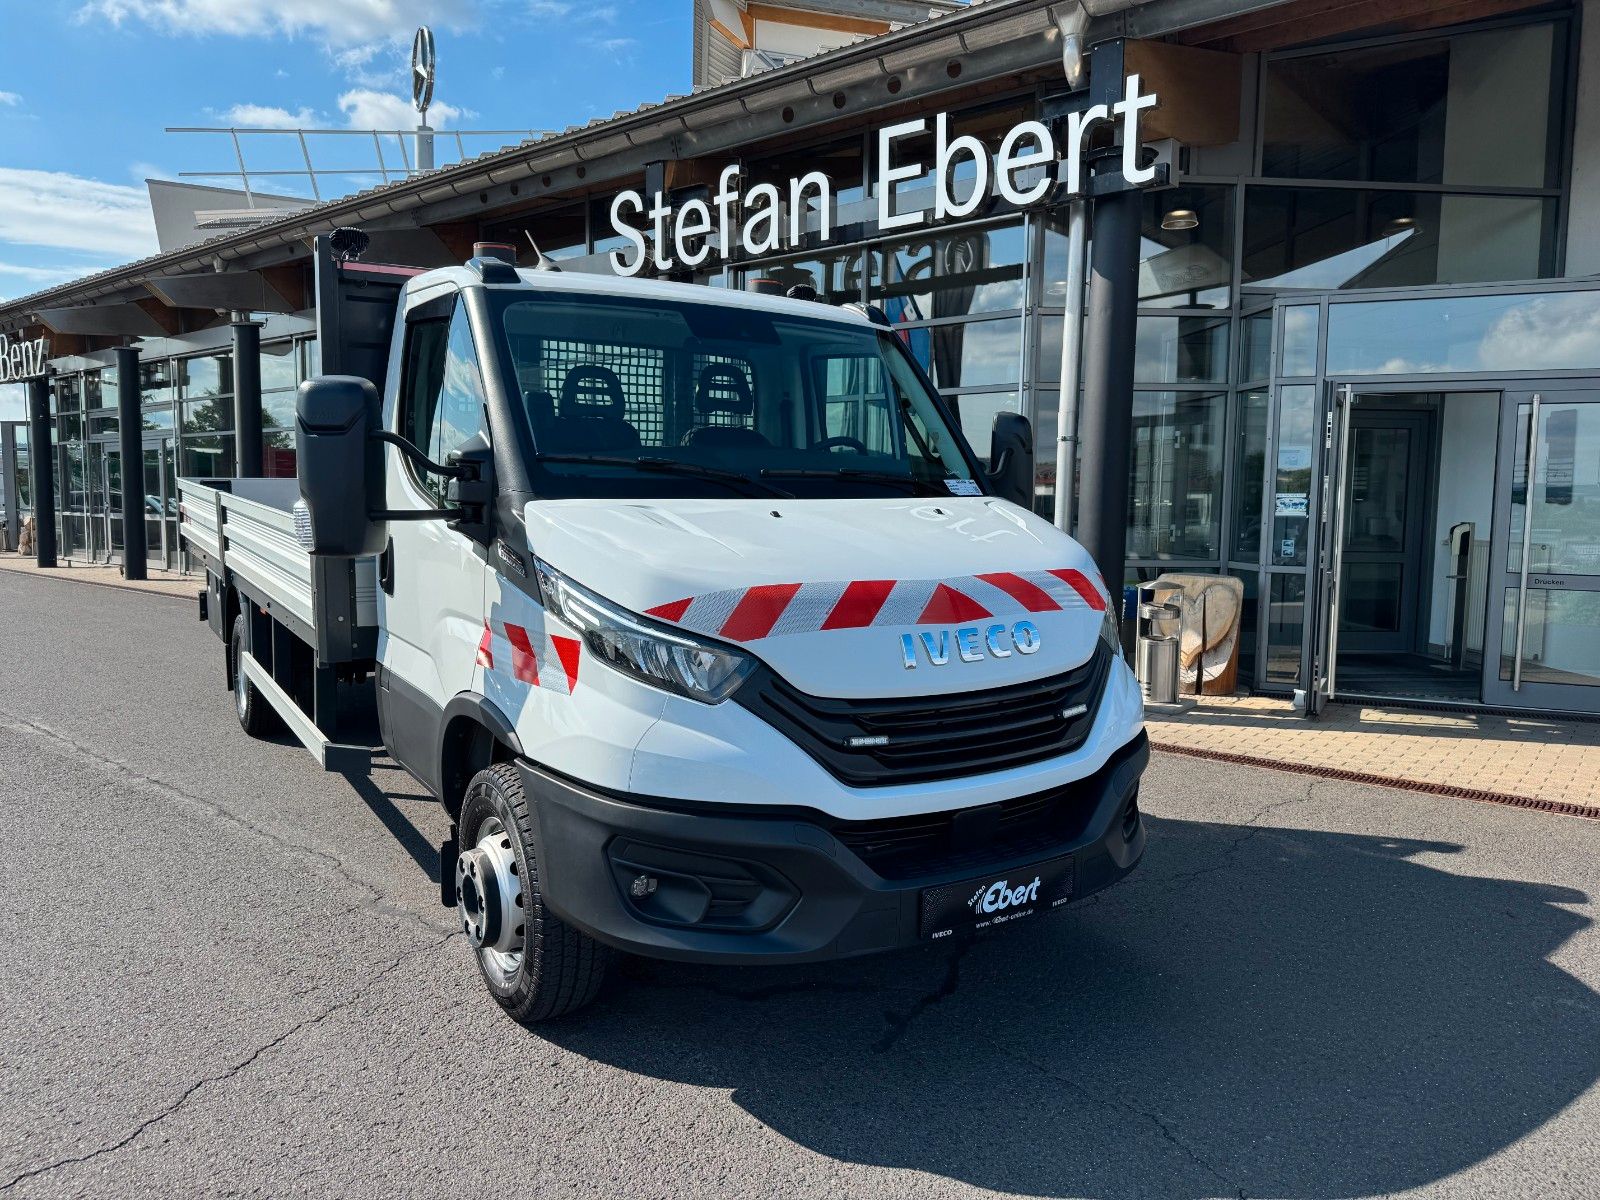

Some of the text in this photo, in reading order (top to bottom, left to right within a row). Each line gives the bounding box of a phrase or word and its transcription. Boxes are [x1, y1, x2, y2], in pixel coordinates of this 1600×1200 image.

[609, 73, 1156, 277] Stefan Ebert
[1534, 578, 1565, 586] Drucken
[899, 620, 1041, 670] IVECO
[967, 885, 986, 907] Stefan
[982, 876, 1041, 913] Ebert
[931, 928, 953, 939] IVECO
